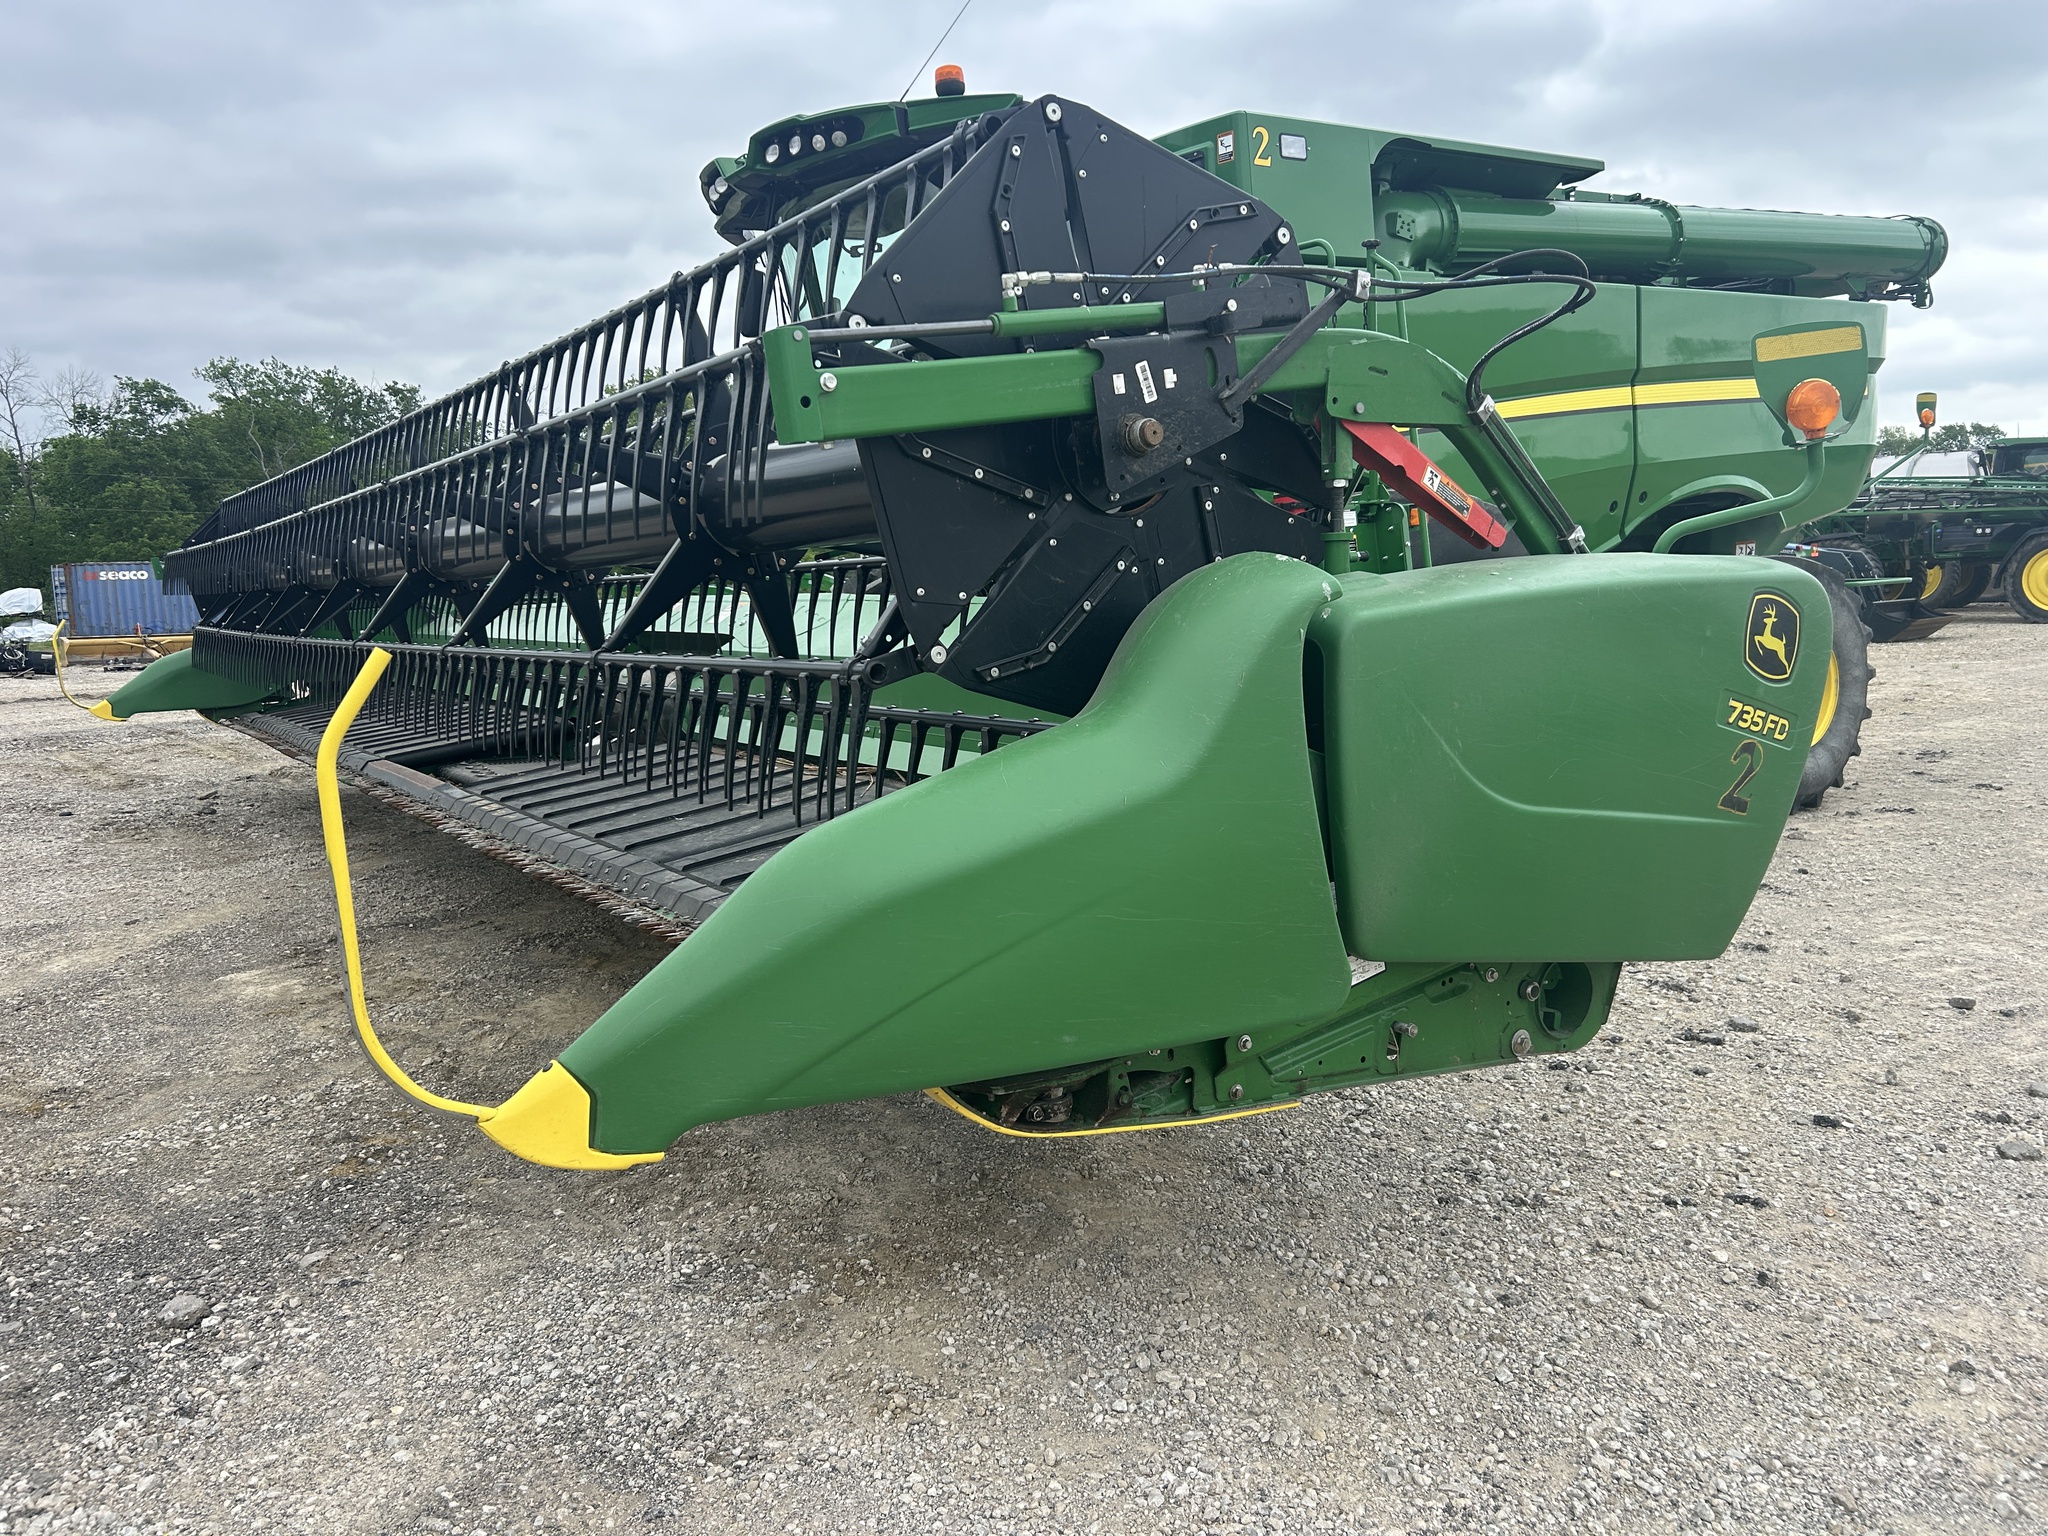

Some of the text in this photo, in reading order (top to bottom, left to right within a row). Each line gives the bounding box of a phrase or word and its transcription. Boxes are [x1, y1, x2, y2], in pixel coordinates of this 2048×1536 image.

[1252, 126, 1272, 167] 2
[99, 570, 149, 581] seaco
[1727, 698, 1790, 742] 735FD
[1717, 739, 1764, 816] 2
